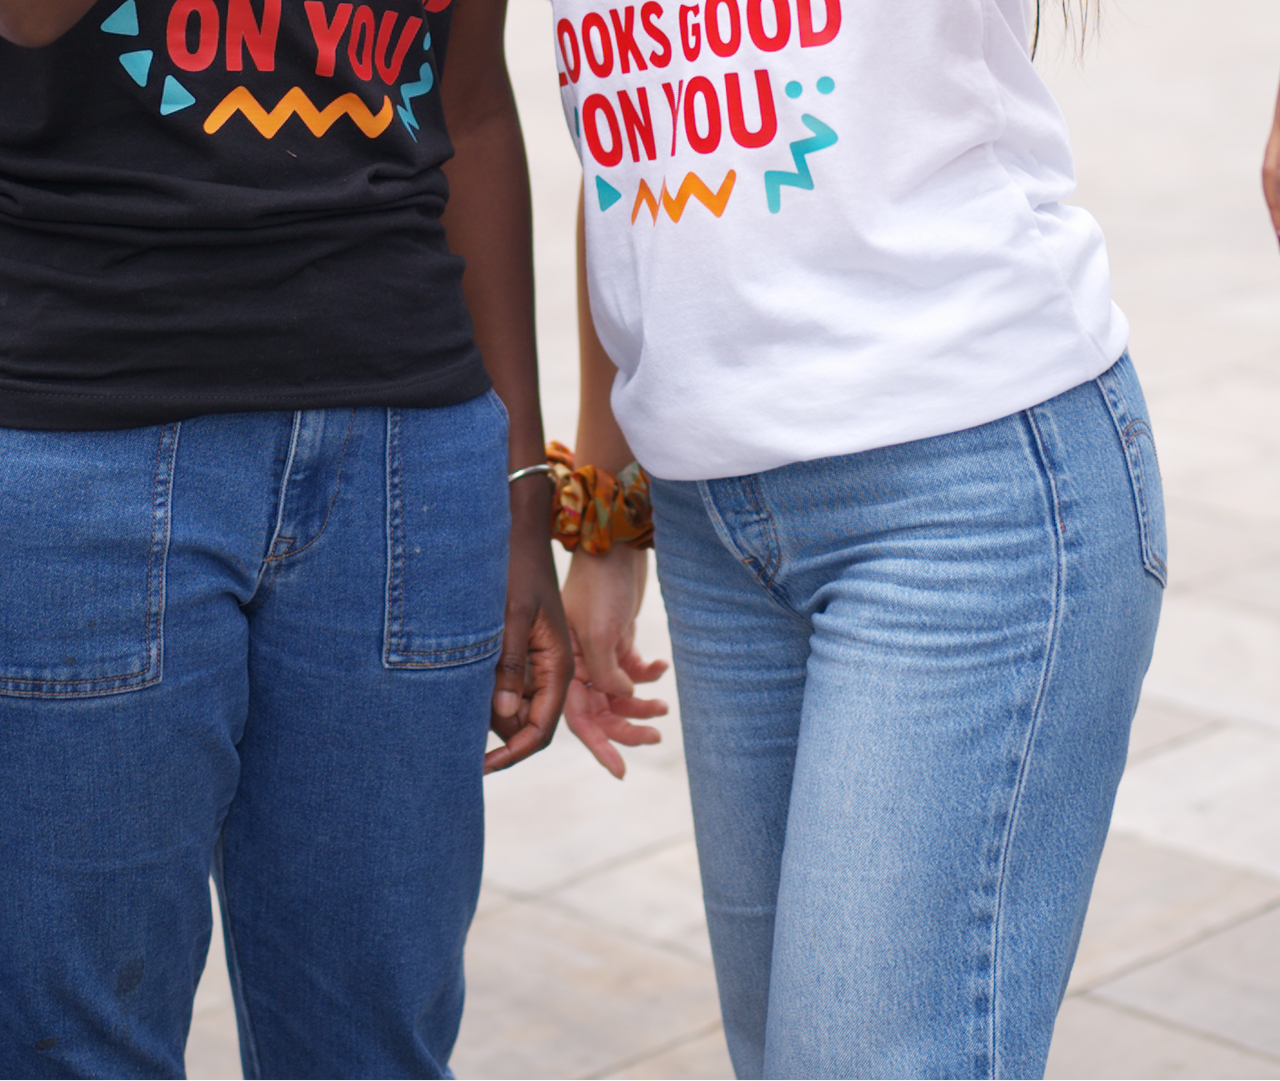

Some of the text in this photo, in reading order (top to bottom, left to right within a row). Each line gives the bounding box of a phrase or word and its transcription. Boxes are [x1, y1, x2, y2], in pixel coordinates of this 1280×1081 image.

[303, 0, 423, 86] YOU
[557, 0, 672, 88] OOKS
[582, 69, 778, 169] ON YOU
